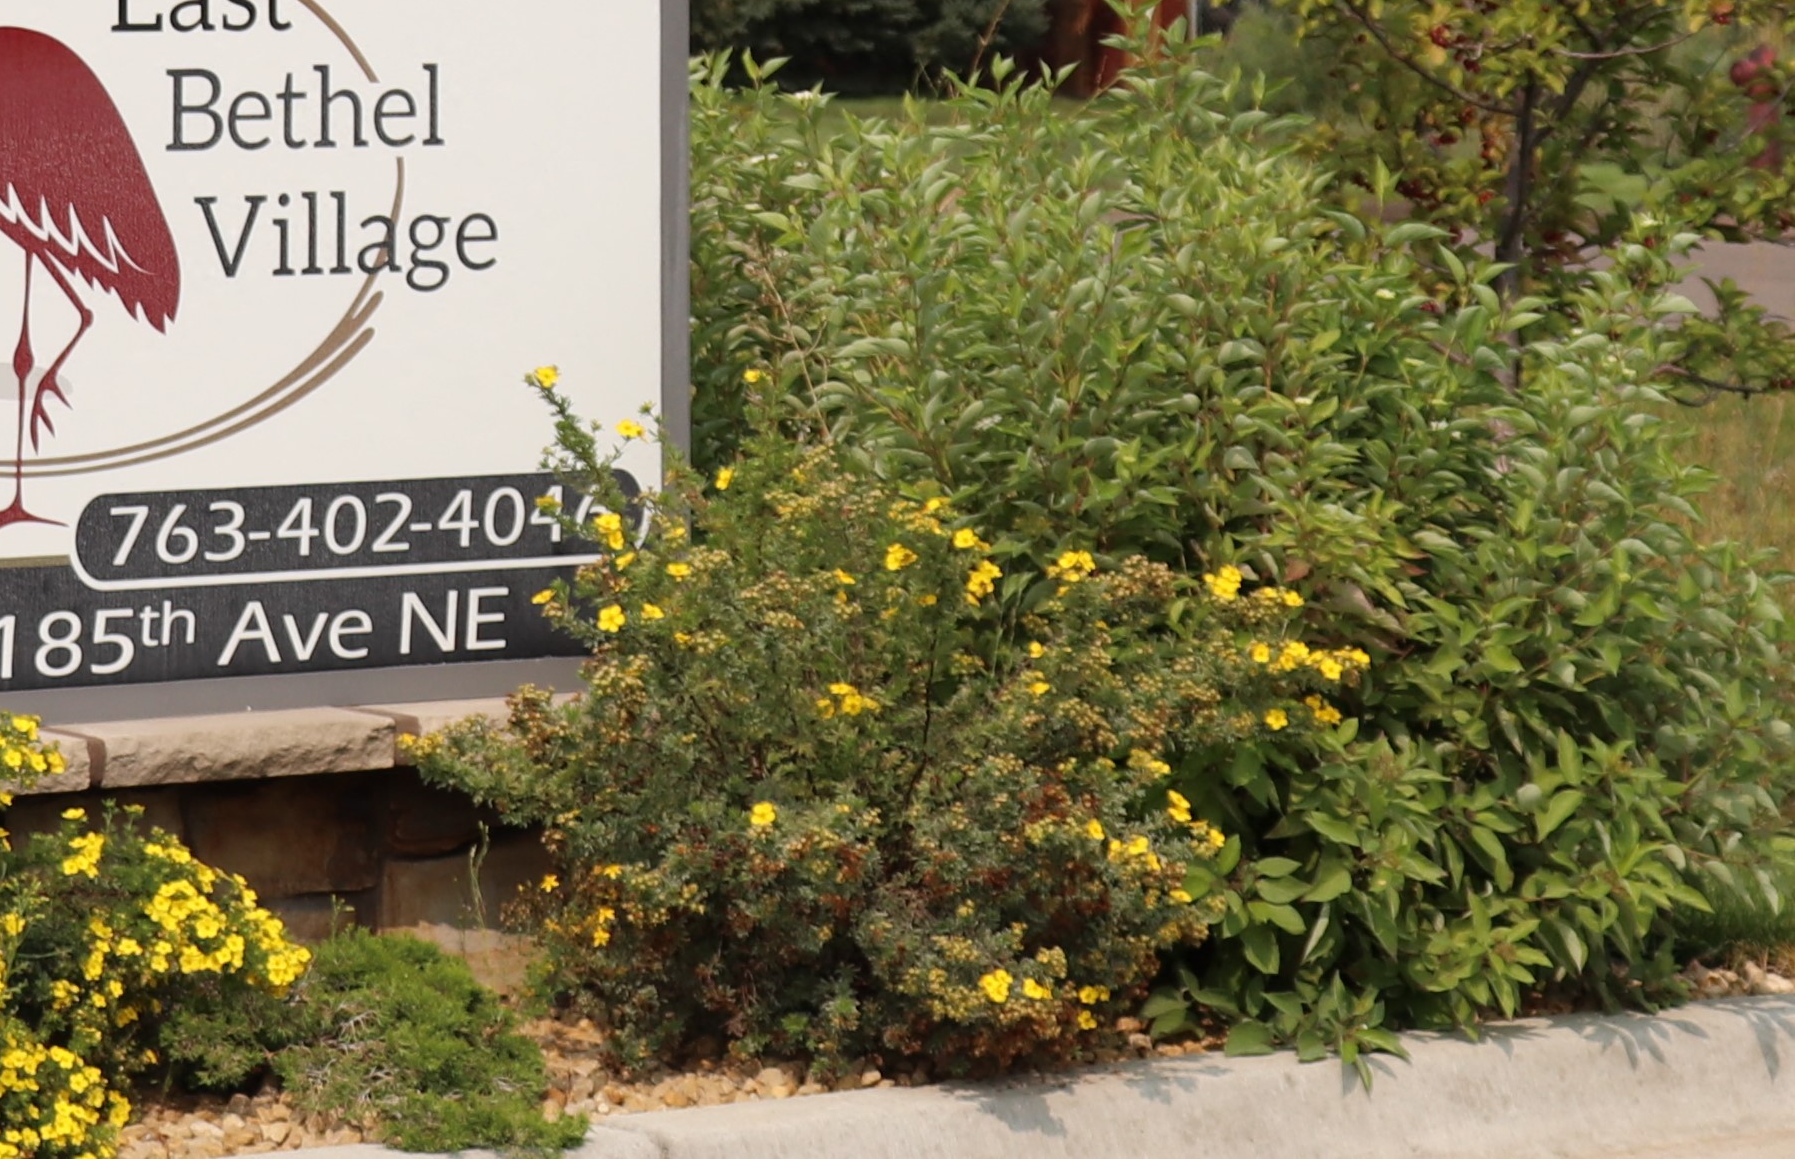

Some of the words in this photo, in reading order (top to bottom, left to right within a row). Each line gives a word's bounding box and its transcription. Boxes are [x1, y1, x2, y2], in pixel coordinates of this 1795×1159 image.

[165, 63, 445, 151] Bethel
[194, 191, 499, 292] Village
[217, 601, 373, 666] Ave
[399, 587, 509, 654] NE
